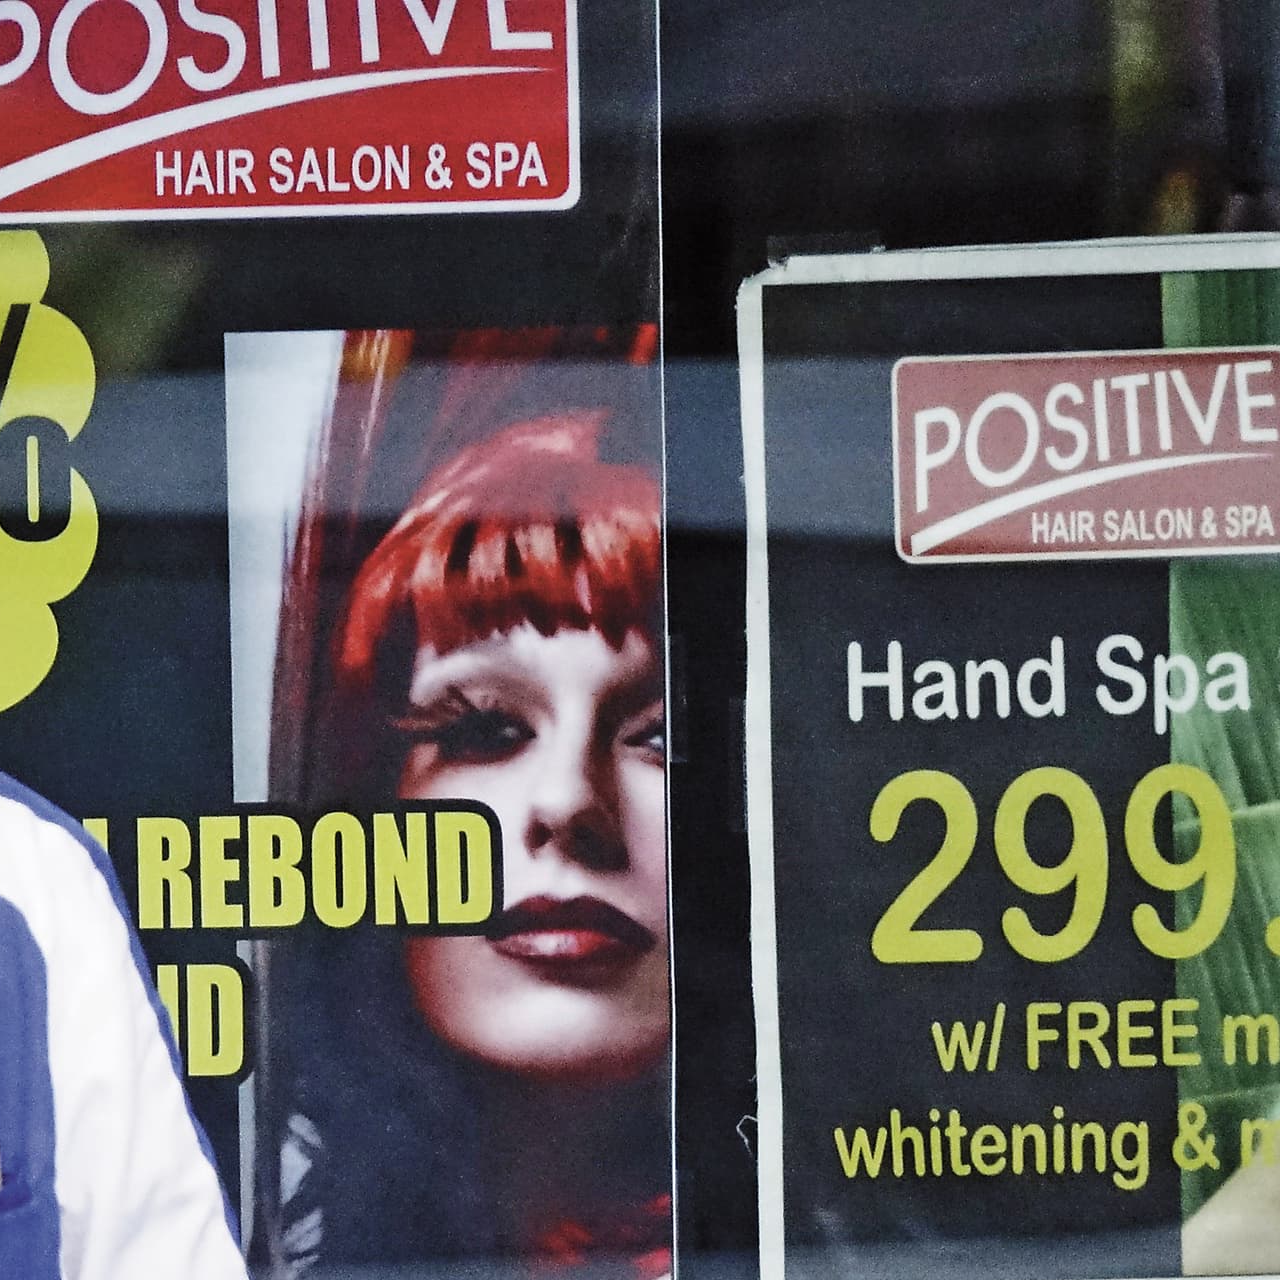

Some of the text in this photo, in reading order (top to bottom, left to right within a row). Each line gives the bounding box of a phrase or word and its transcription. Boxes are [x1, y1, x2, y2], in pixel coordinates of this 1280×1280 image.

[155, 141, 549, 196] HAIR SALON & SPA
[914, 359, 1279, 513] POSITIVE
[1031, 504, 1276, 545] HAIR SALON & SPA
[846, 635, 1067, 723] Hand
[1095, 633, 1251, 735] Spa
[136, 811, 494, 930] REBOND
[931, 1003, 1007, 1072] w/
[1025, 998, 1202, 1069] FREE
[833, 1105, 1150, 1191] whitening
[1172, 1101, 1221, 1172] &
